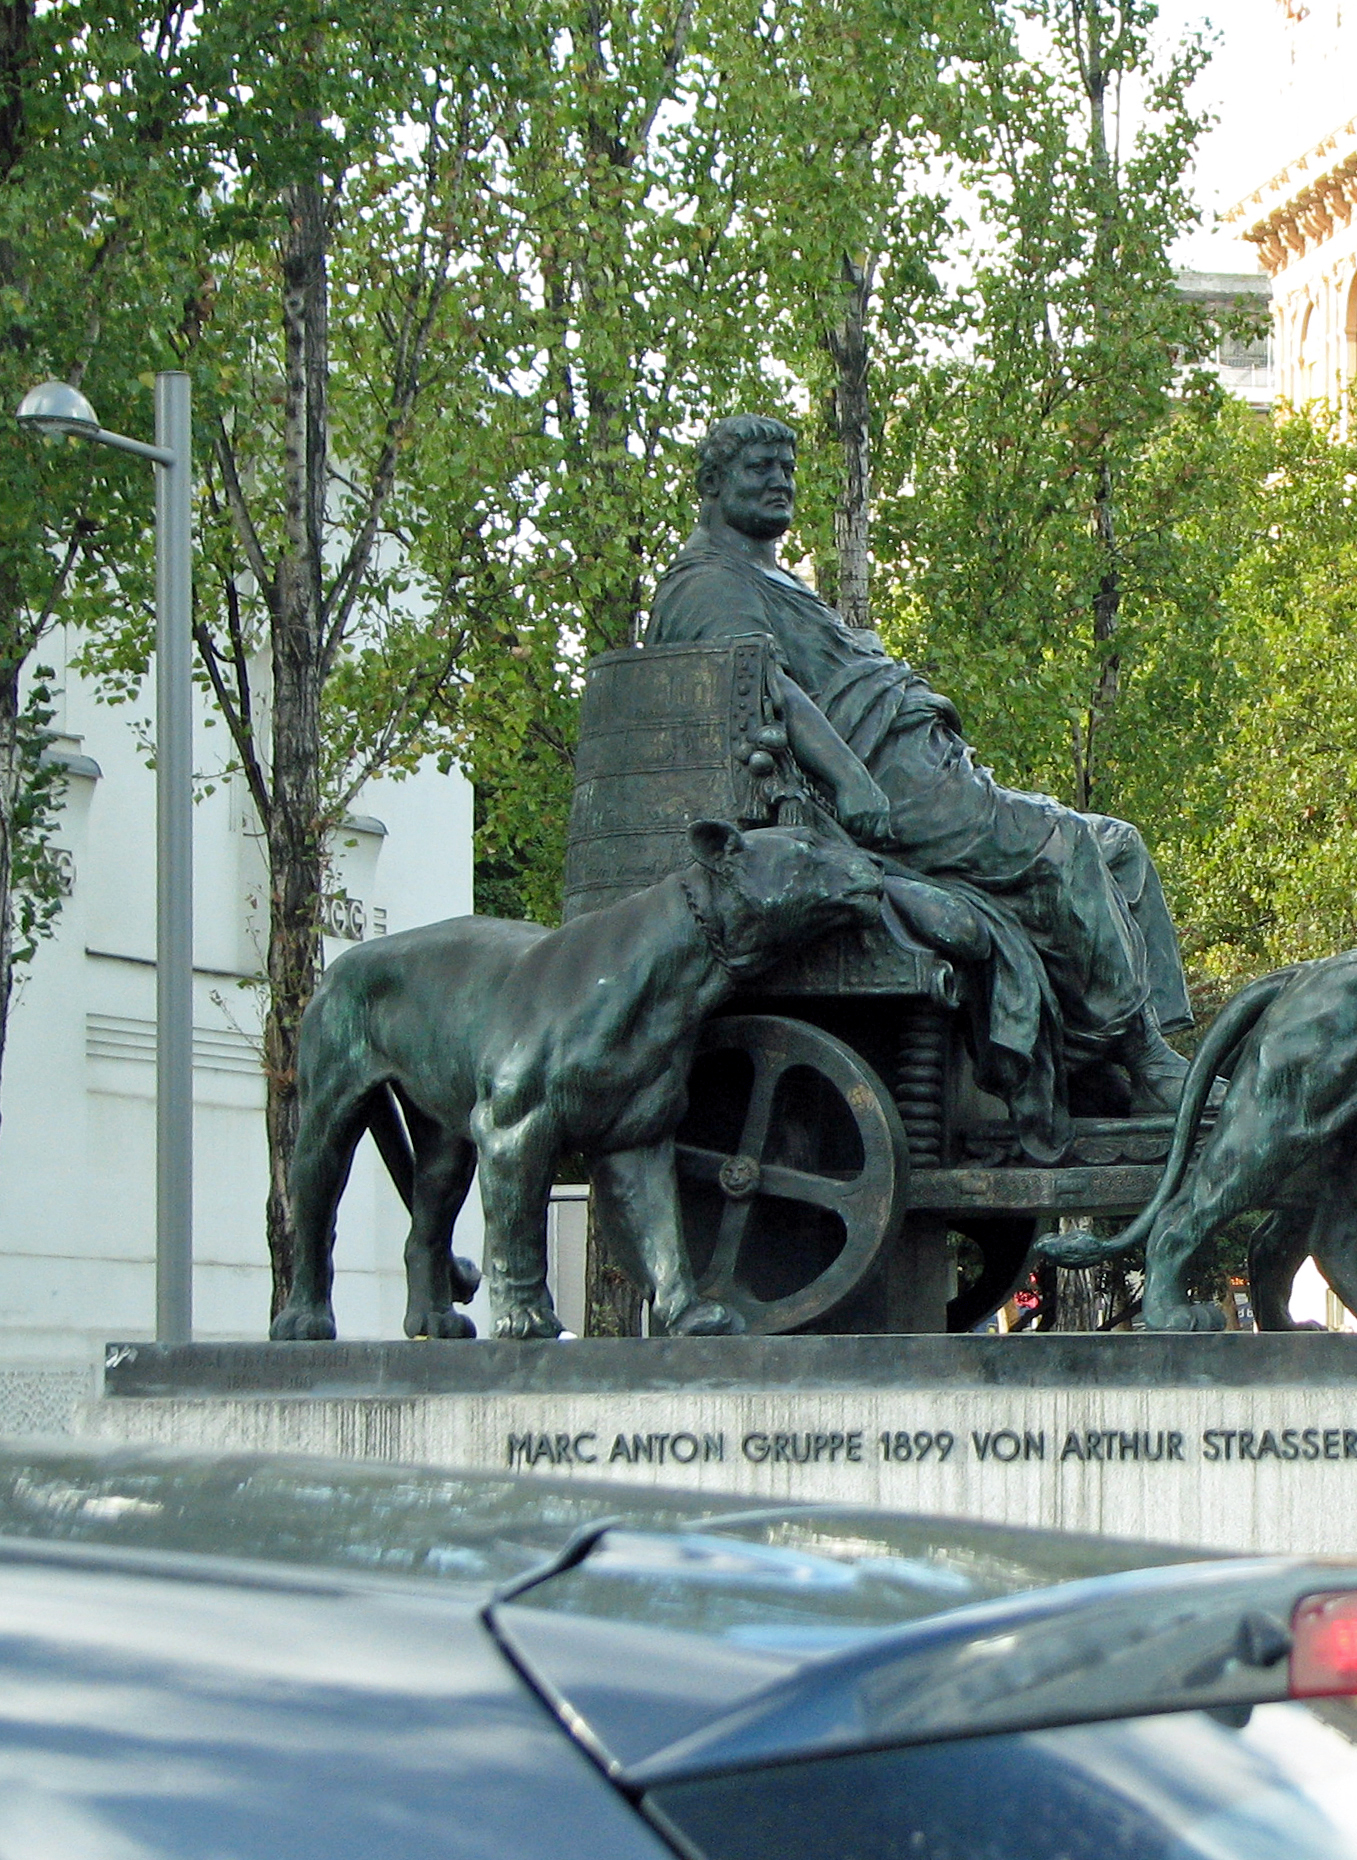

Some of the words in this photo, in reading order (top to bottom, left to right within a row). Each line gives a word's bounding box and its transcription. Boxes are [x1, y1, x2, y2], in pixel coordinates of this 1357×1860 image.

[507, 1431, 598, 1468] MARC
[609, 1431, 725, 1465] ANTON
[741, 1430, 862, 1463] GRUPPE
[878, 1430, 955, 1463] 1899
[971, 1429, 1045, 1462] VON
[1060, 1428, 1184, 1462] ARTHUR
